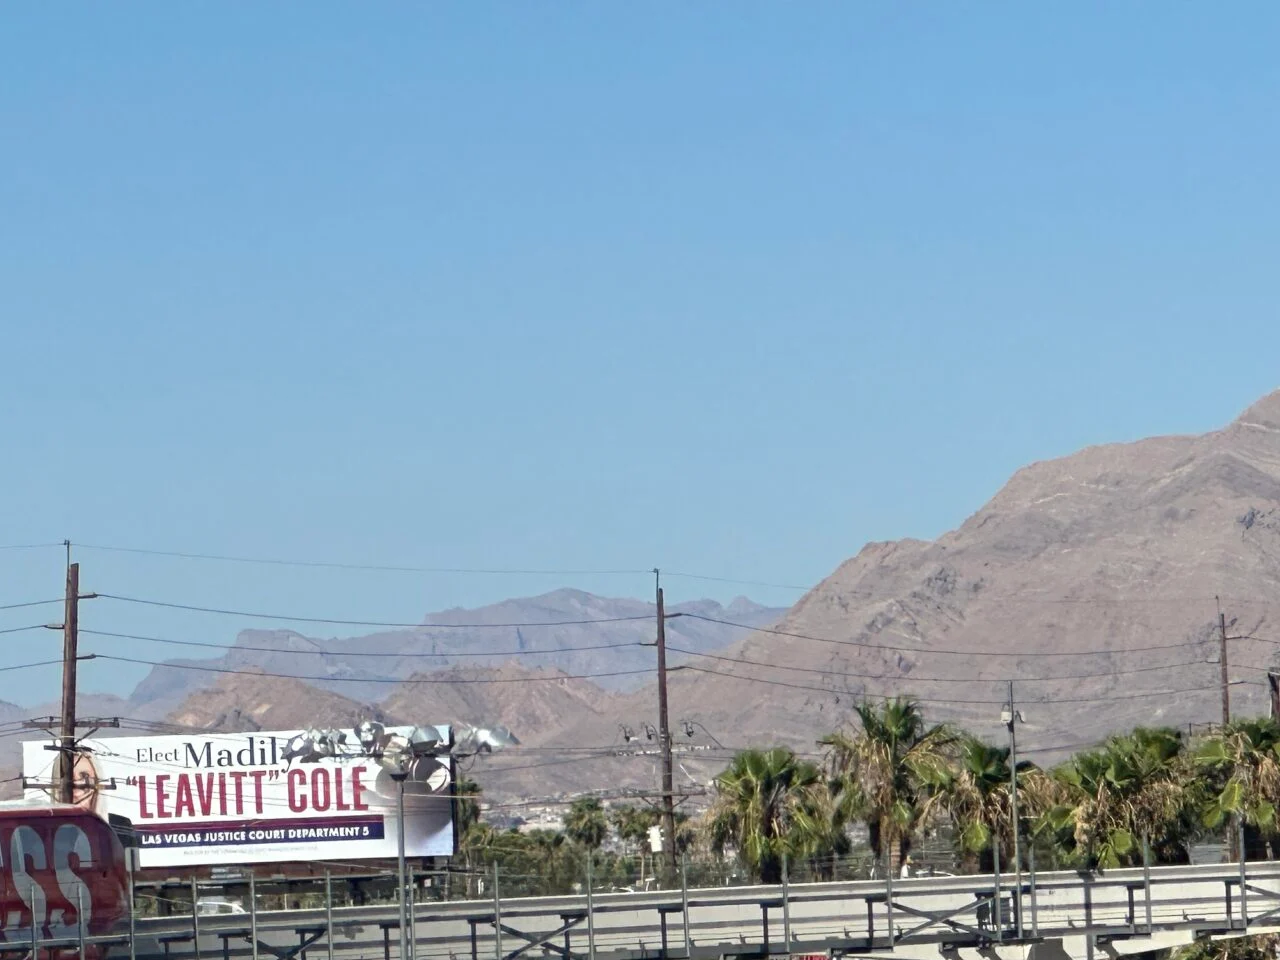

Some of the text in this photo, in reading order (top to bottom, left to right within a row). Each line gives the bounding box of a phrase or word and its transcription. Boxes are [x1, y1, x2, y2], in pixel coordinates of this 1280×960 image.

[136, 747, 180, 763] Elect
[287, 766, 369, 813] COLE
[142, 825, 370, 845] LAS VEGAS JUSTICE COURT DEPARTMENT 5
